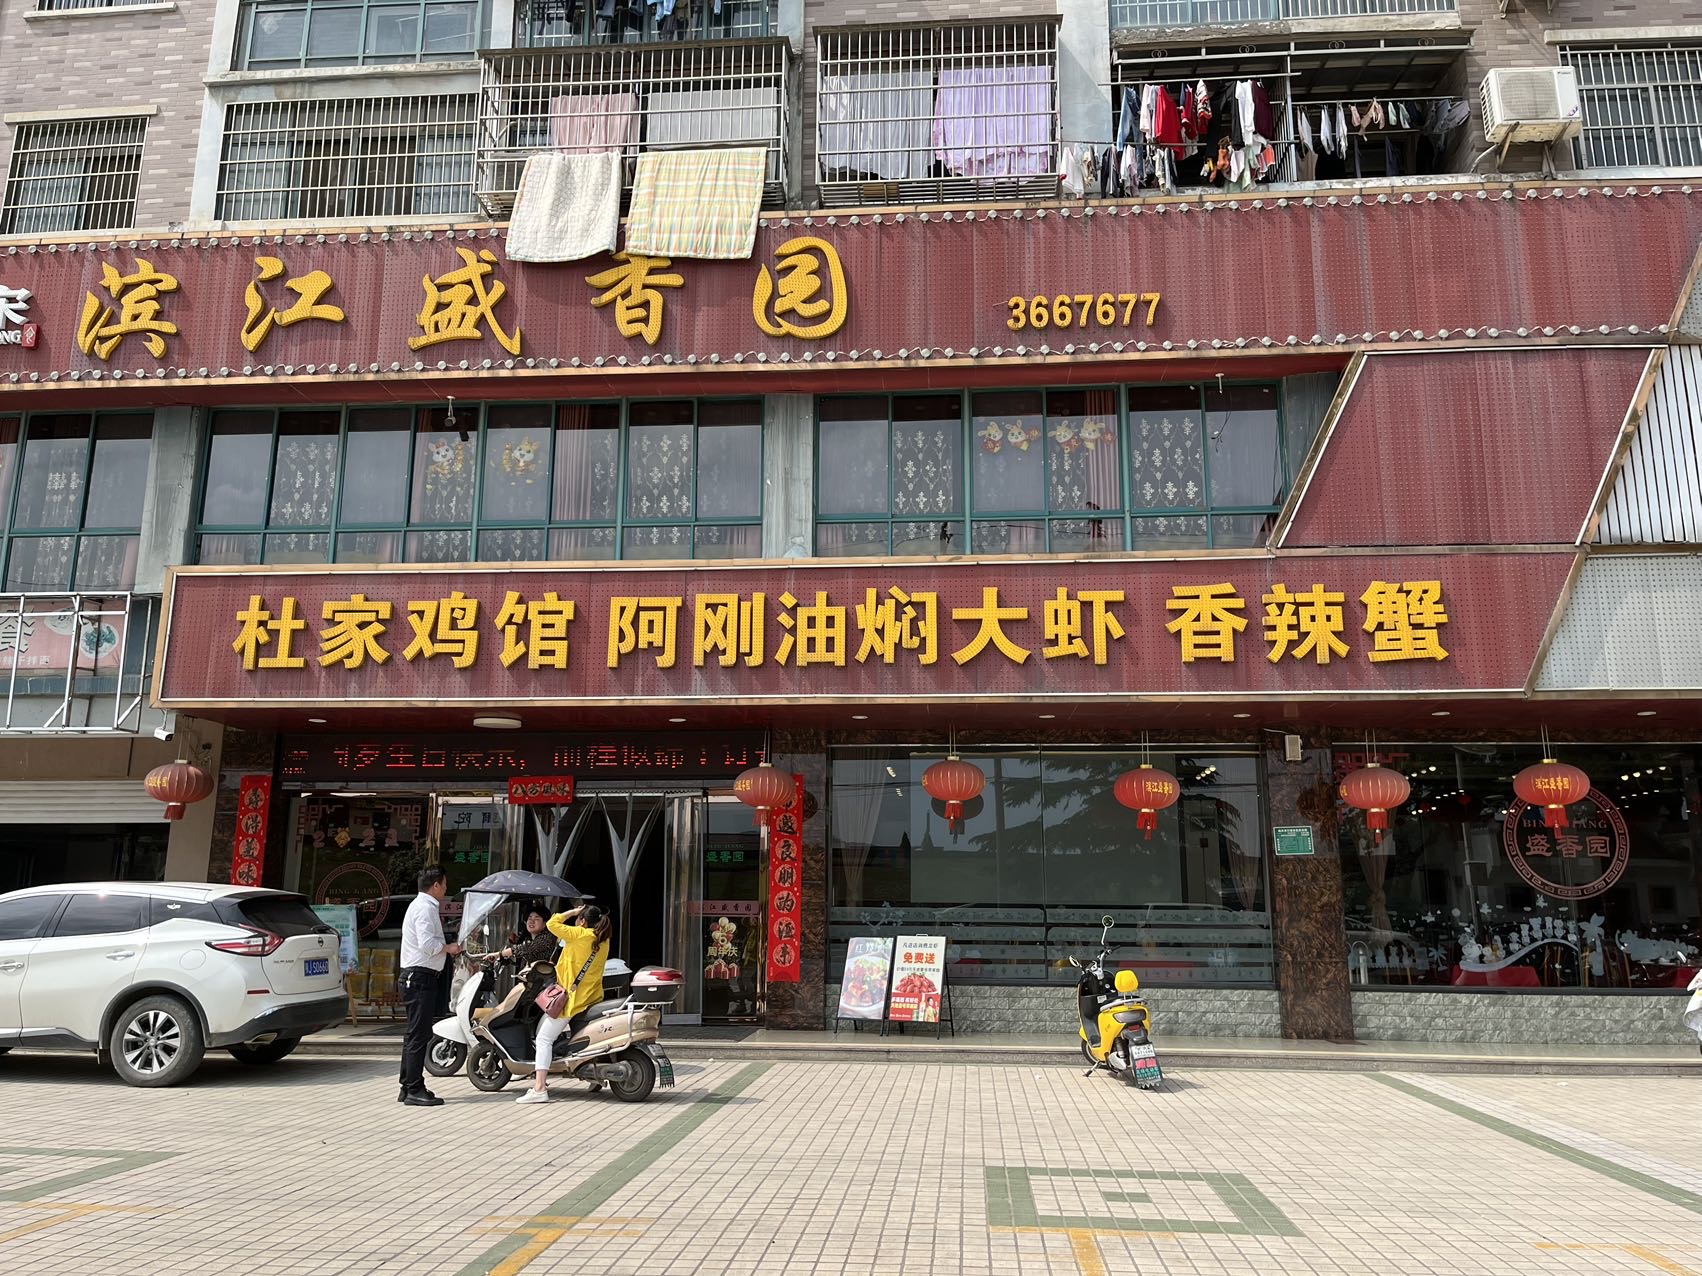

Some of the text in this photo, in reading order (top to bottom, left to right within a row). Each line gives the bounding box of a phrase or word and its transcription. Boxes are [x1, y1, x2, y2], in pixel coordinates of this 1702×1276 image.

[76, 236, 1161, 360] 滨江盛香园 3667677
[232, 579, 1450, 671] 杜家鸡馆 阿刚油焖大虾 香辣蟹
[1525, 833, 1611, 858] 盛香园
[701, 903, 752, 912] 江盛香园
[706, 946, 739, 958] 周年庆
[902, 951, 936, 965] 免费送
